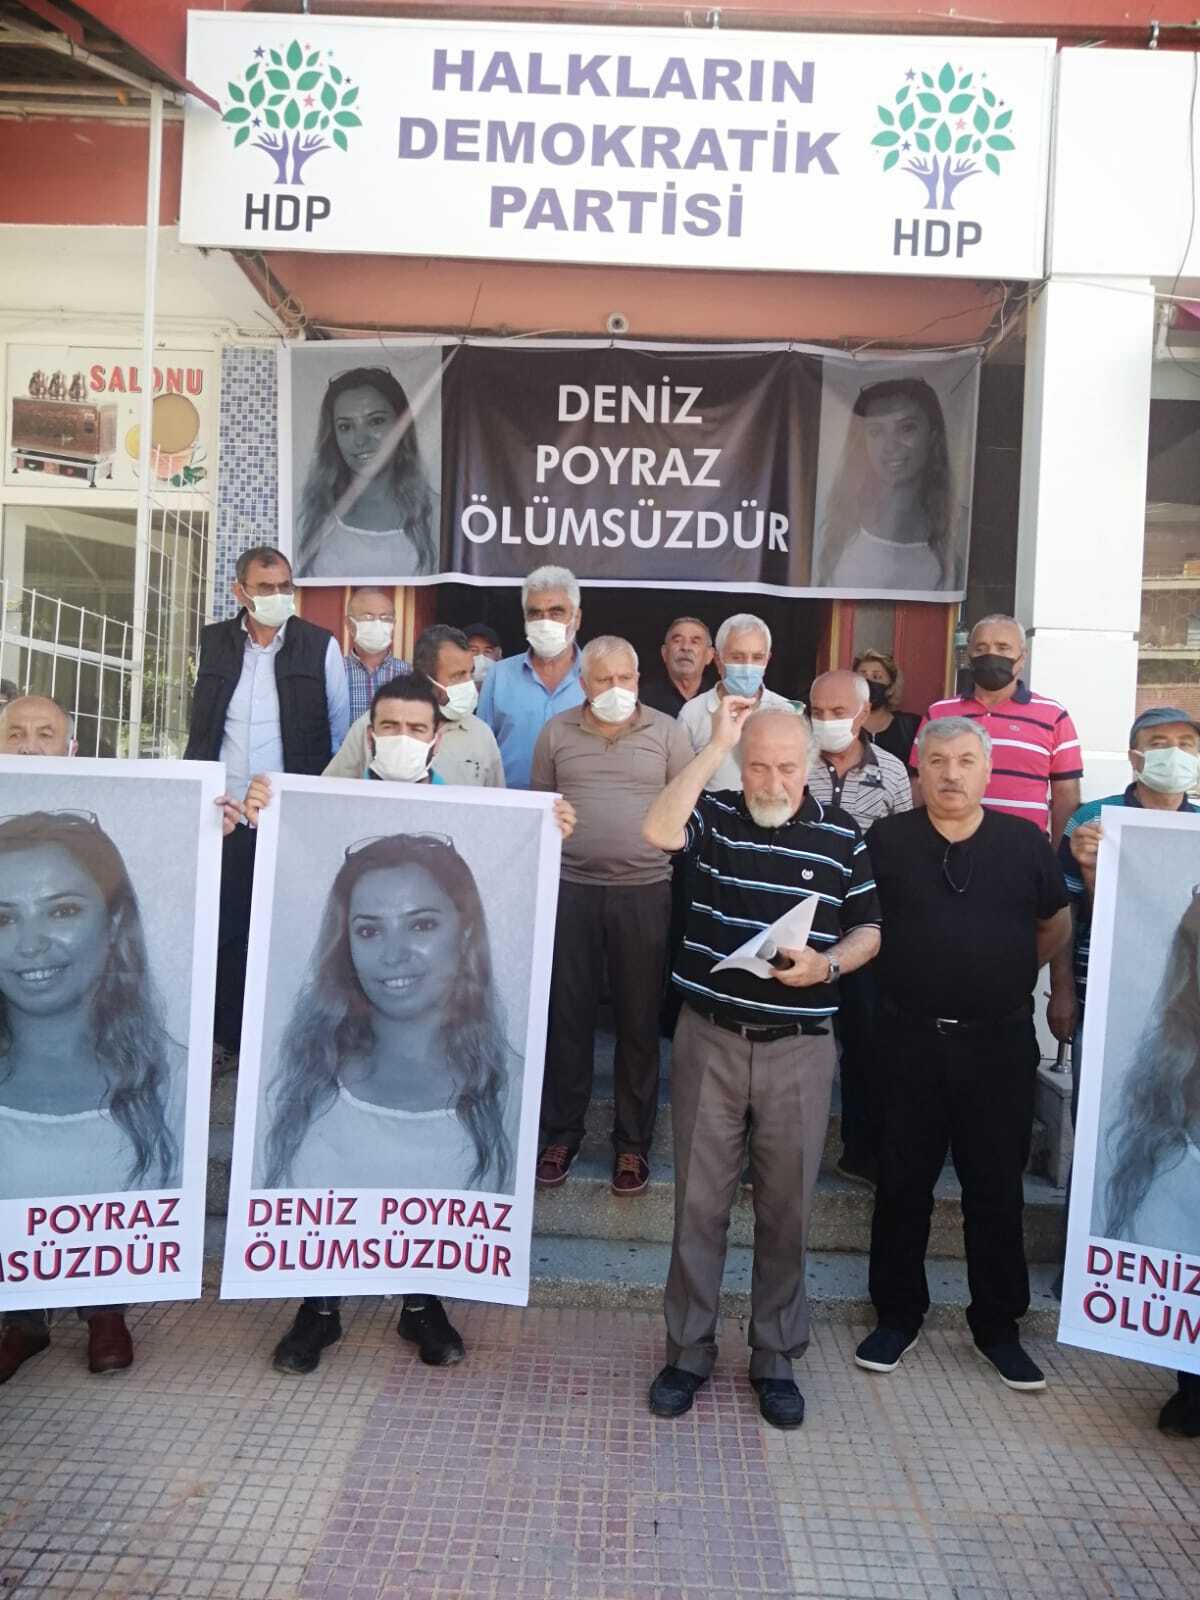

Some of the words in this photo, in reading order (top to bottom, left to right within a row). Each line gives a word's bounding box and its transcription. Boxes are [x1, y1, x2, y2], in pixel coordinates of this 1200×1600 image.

[432, 49, 815, 104] HALKLARIN
[398, 117, 841, 175] DEMOKRATİK
[245, 193, 331, 232] HDP
[490, 182, 744, 238] PARTİSİ
[894, 219, 983, 258] HDP
[558, 375, 703, 425] DENİZ
[536, 445, 722, 488] POYRAZ
[461, 493, 790, 553] ÖLÜMSÜZDÜR
[27, 1198, 181, 1236] POYRAZ
[247, 1189, 358, 1227] DENİZ
[380, 1197, 513, 1233] POYRAZ
[0, 1233, 181, 1283] SÜZDÜR
[244, 1230, 512, 1278] ÖLÜMSÜZDÜR
[1087, 1245, 1200, 1296] DENİZ
